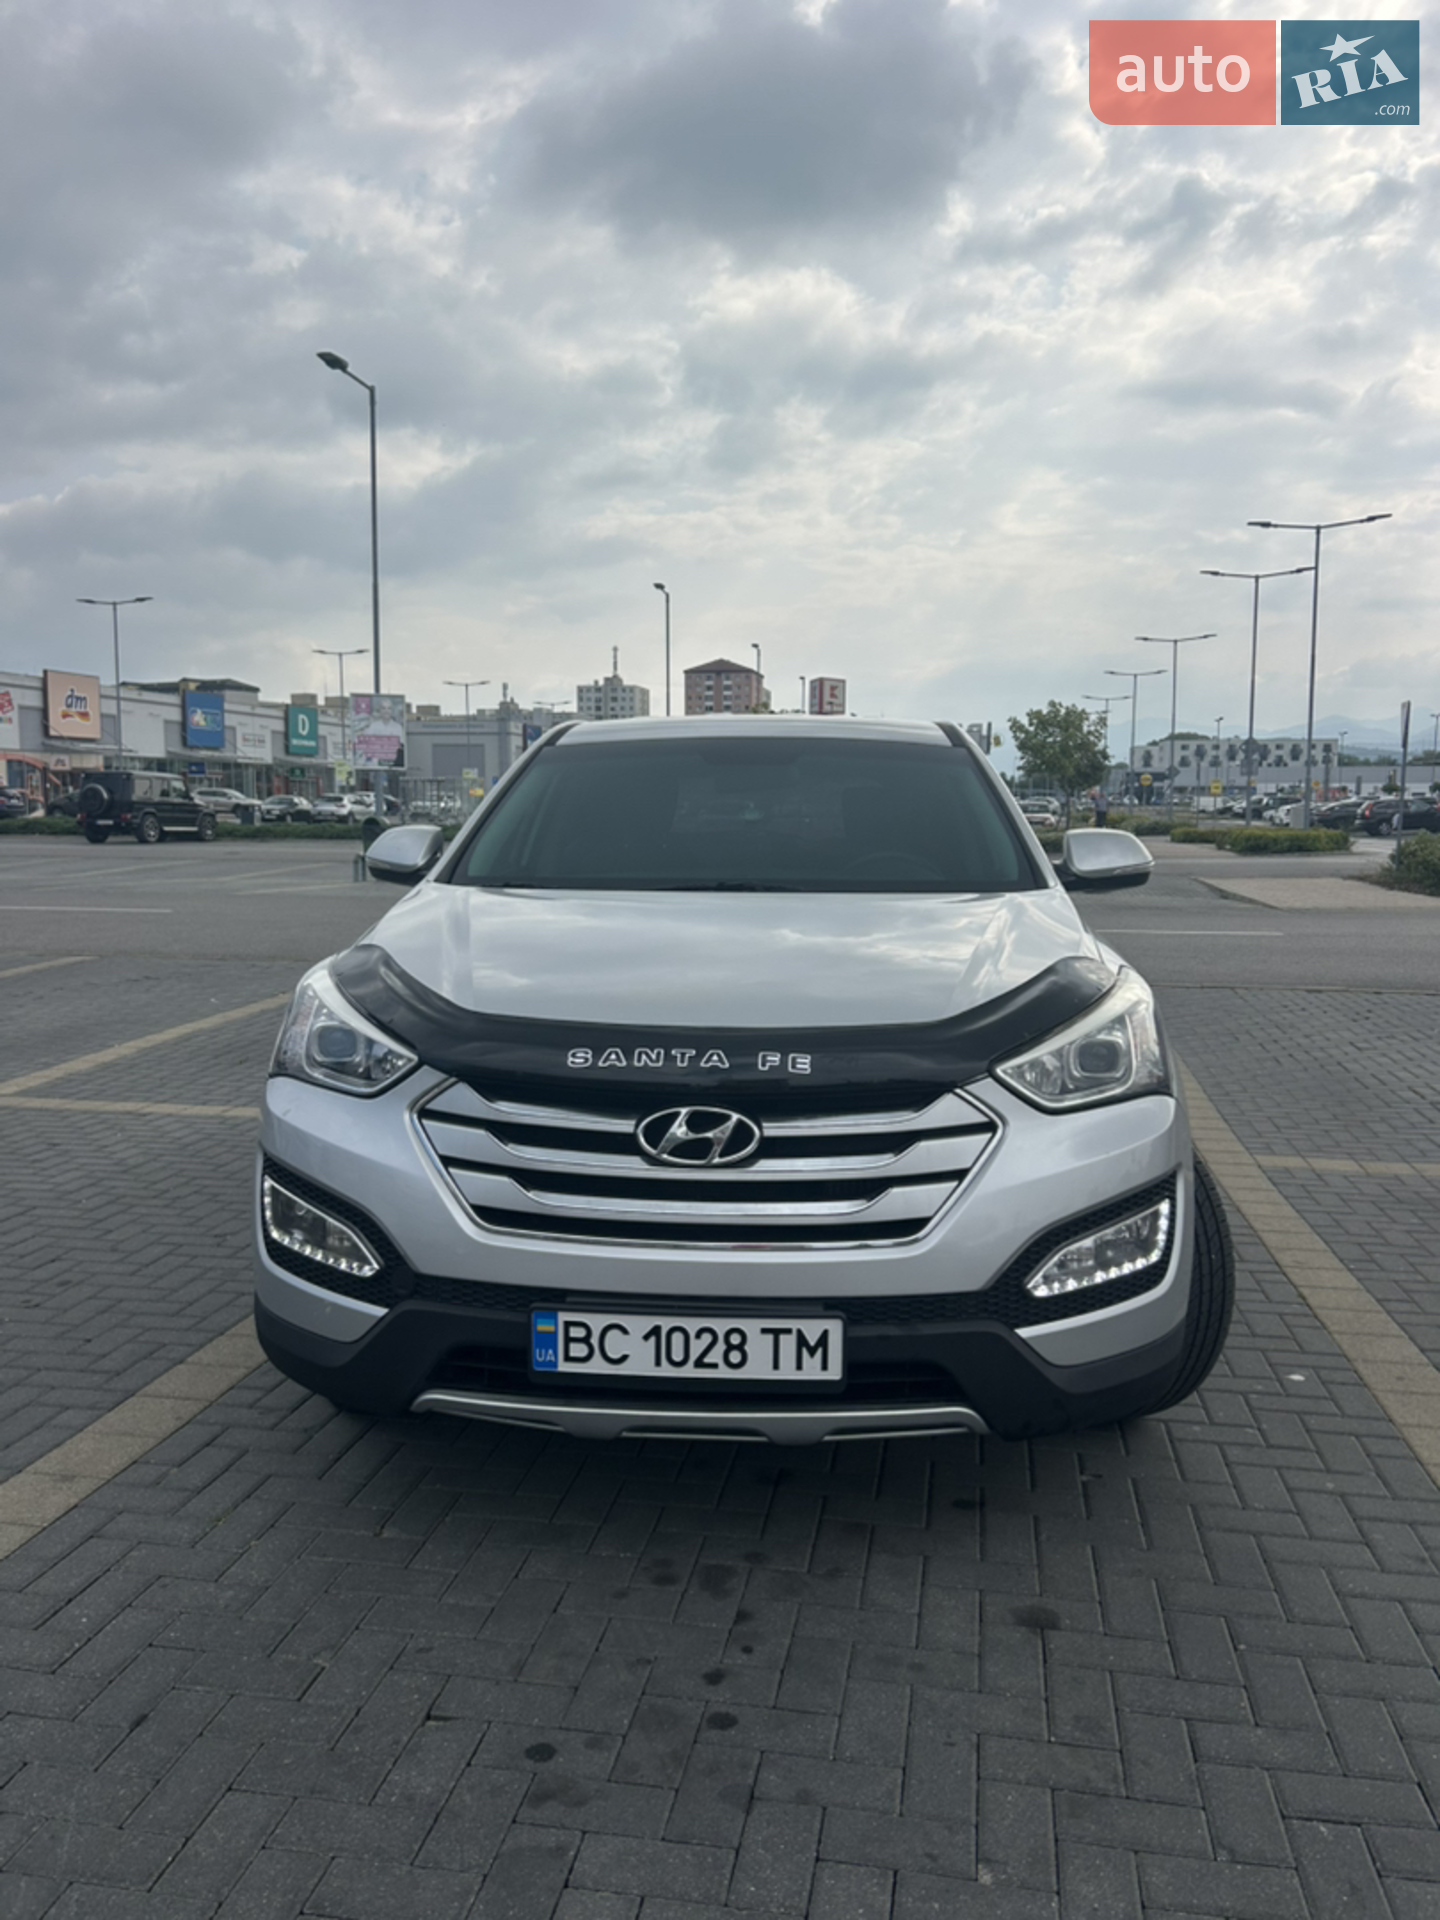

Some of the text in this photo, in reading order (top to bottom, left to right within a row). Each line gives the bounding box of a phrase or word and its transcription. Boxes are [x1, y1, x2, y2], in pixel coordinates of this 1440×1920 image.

[65, 688, 87, 709] dm
[829, 686, 840, 699] K
[298, 714, 309, 736] D
[567, 1047, 812, 1074] SANTA FE
[536, 1348, 556, 1363] UA
[562, 1320, 829, 1372] BC 1028 TM
